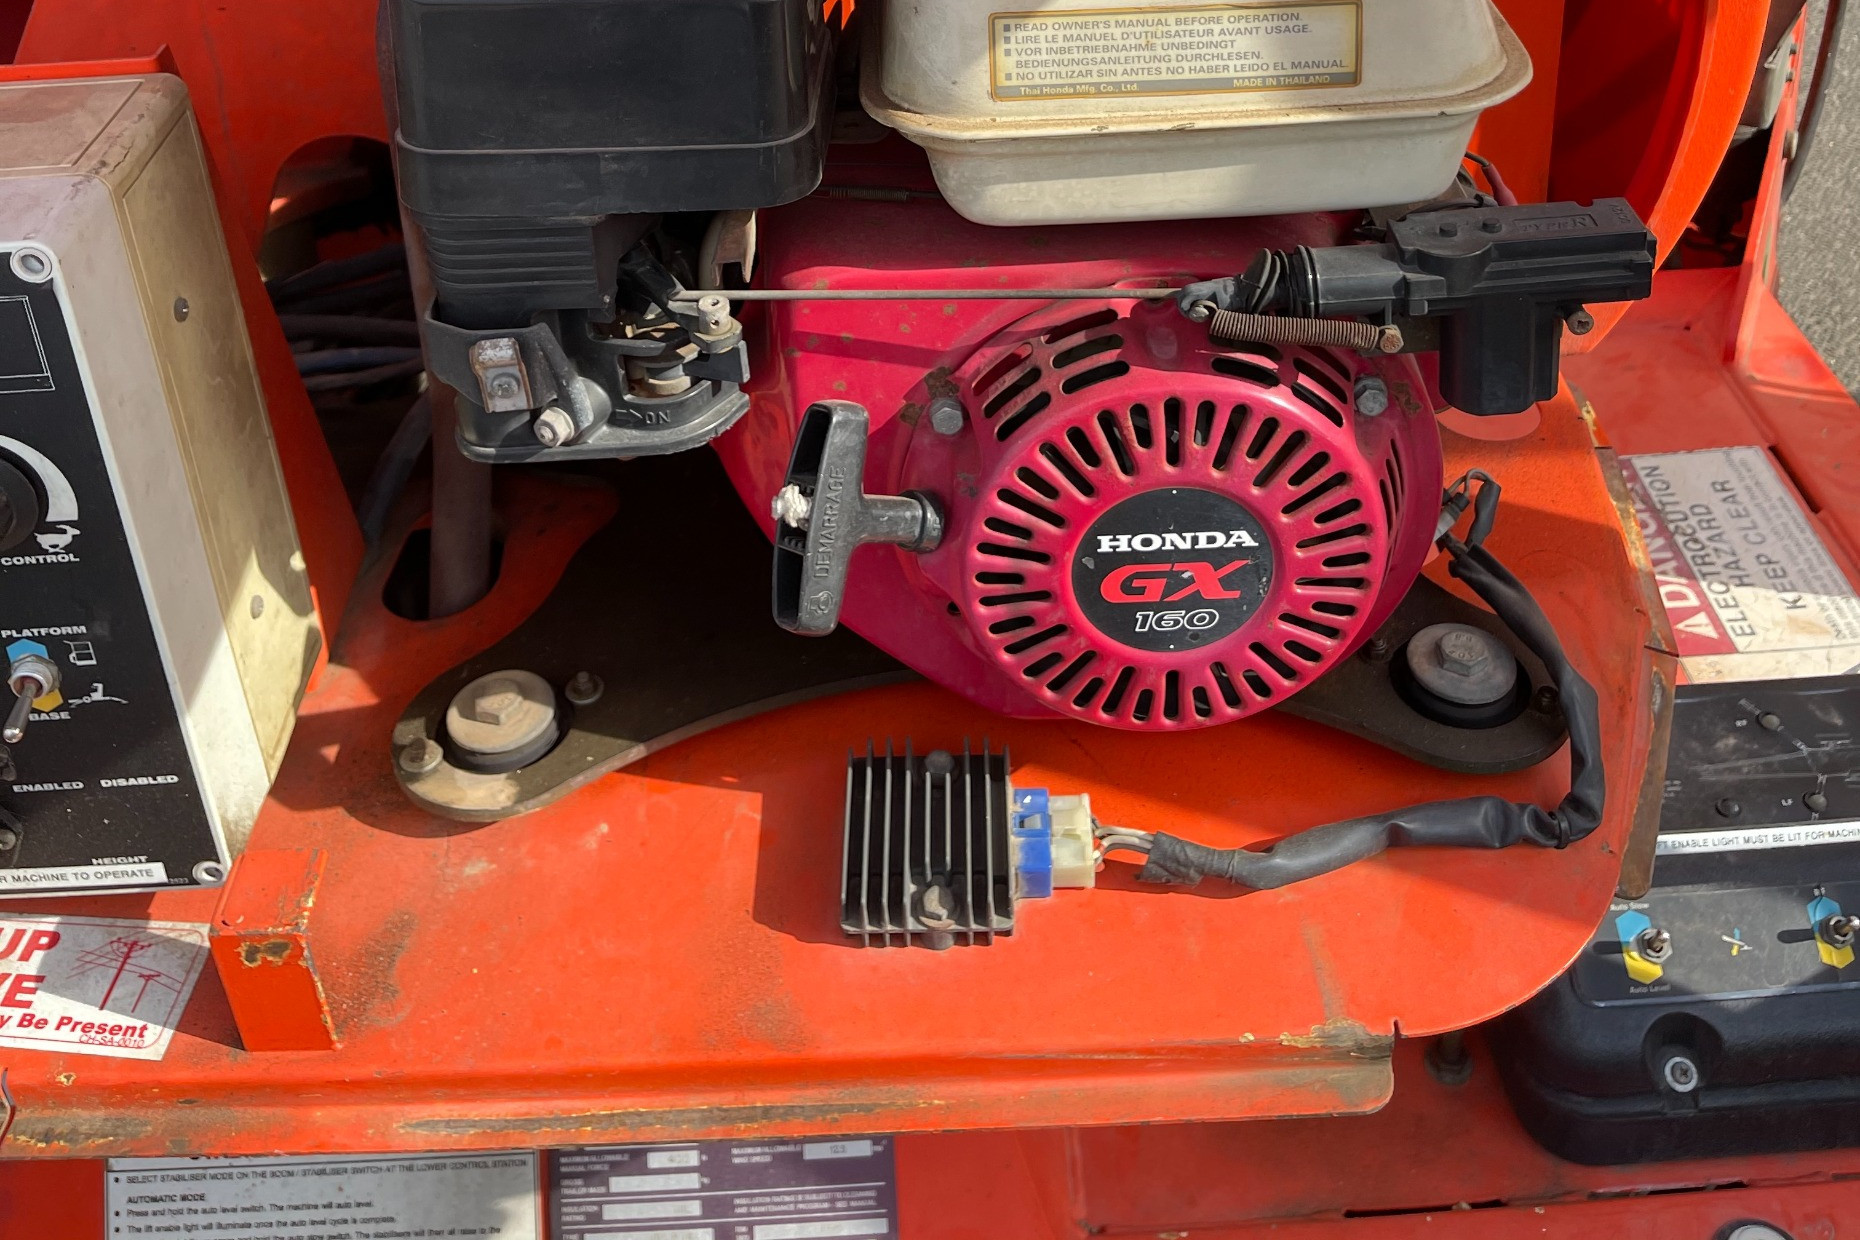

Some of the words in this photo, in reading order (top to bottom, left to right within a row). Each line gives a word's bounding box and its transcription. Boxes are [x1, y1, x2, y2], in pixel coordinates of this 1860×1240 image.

[1014, 22, 1048, 32] READ
[1052, 20, 1111, 31] OWNER'S
[1114, 18, 1171, 29] MANUAL
[1175, 16, 1223, 26] BEFORE
[1227, 12, 1303, 24] OPERATION.
[1014, 35, 1041, 44] LIRE
[1045, 34, 1059, 43] LE
[1062, 32, 1118, 43] MANUEL
[1121, 28, 1215, 41] D'UTILISATEUR
[1218, 26, 1261, 37] AVANT
[1265, 24, 1313, 34] USAGE.
[1015, 47, 1042, 56] VOR
[1046, 43, 1157, 55] INBETRIEBNAHME
[1161, 39, 1236, 51] UNBEDINGT
[1015, 54, 1172, 69] BEDIENUNGSANLEITUNG
[1176, 51, 1264, 63] DURCHLESEN.
[1016, 72, 1035, 81] NO
[1038, 70, 1093, 80] UTILIZAR
[1096, 68, 1118, 78] SIN
[1121, 67, 1162, 77] ANTES
[1166, 65, 1185, 75] NO
[1188, 63, 1230, 74] HABER
[1233, 62, 1269, 72] LEIDO
[1273, 61, 1288, 71] EL
[1019, 86, 1041, 95] Thai
[1043, 85, 1074, 95] Honda
[1076, 84, 1098, 94] Mfg.
[1122, 83, 1140, 92] Ltd.
[1233, 77, 1263, 87] MADE
[1265, 76, 1277, 86] IN
[1279, 75, 1331, 86] THAILAND
[814, 465, 847, 578] DEMARRAGE
[1710, 479, 1768, 545] CLEAR
[1097, 529, 1259, 553] HONDA
[1689, 503, 1755, 588] HAZARD
[1, 552, 80, 567] CONTROL
[1100, 558, 1254, 603] GX
[1763, 552, 1807, 610] KEEP
[1135, 607, 1220, 632] 160
[1, 626, 87, 638] PLATFORM
[28, 711, 71, 722] BASE
[13, 781, 85, 793] ENABLED
[100, 774, 180, 788] DISABLED
[1671, 838, 1709, 849] ENABLE
[1711, 836, 1741, 847] LIGHT
[1743, 834, 1769, 844] MUST
[1772, 833, 1785, 843] BE
[1788, 832, 1802, 842] LIT
[1805, 830, 1825, 840] FOR
[91, 855, 149, 865] HEIGHT
[12, 871, 69, 883] MACHINE
[72, 871, 90, 881] TO
[93, 868, 154, 880] OPERATE
[17, 1013, 49, 1030] Be
[54, 1016, 149, 1039] Present
[126, 1193, 177, 1204] AUTOMATIC
[179, 1192, 206, 1202] MODE
[151, 1208, 166, 1217] and
[186, 1206, 198, 1215] the
[201, 1206, 217, 1215] auto
[219, 1204, 238, 1214] level
[270, 1203, 284, 1212] The
[127, 1224, 142, 1234] The
